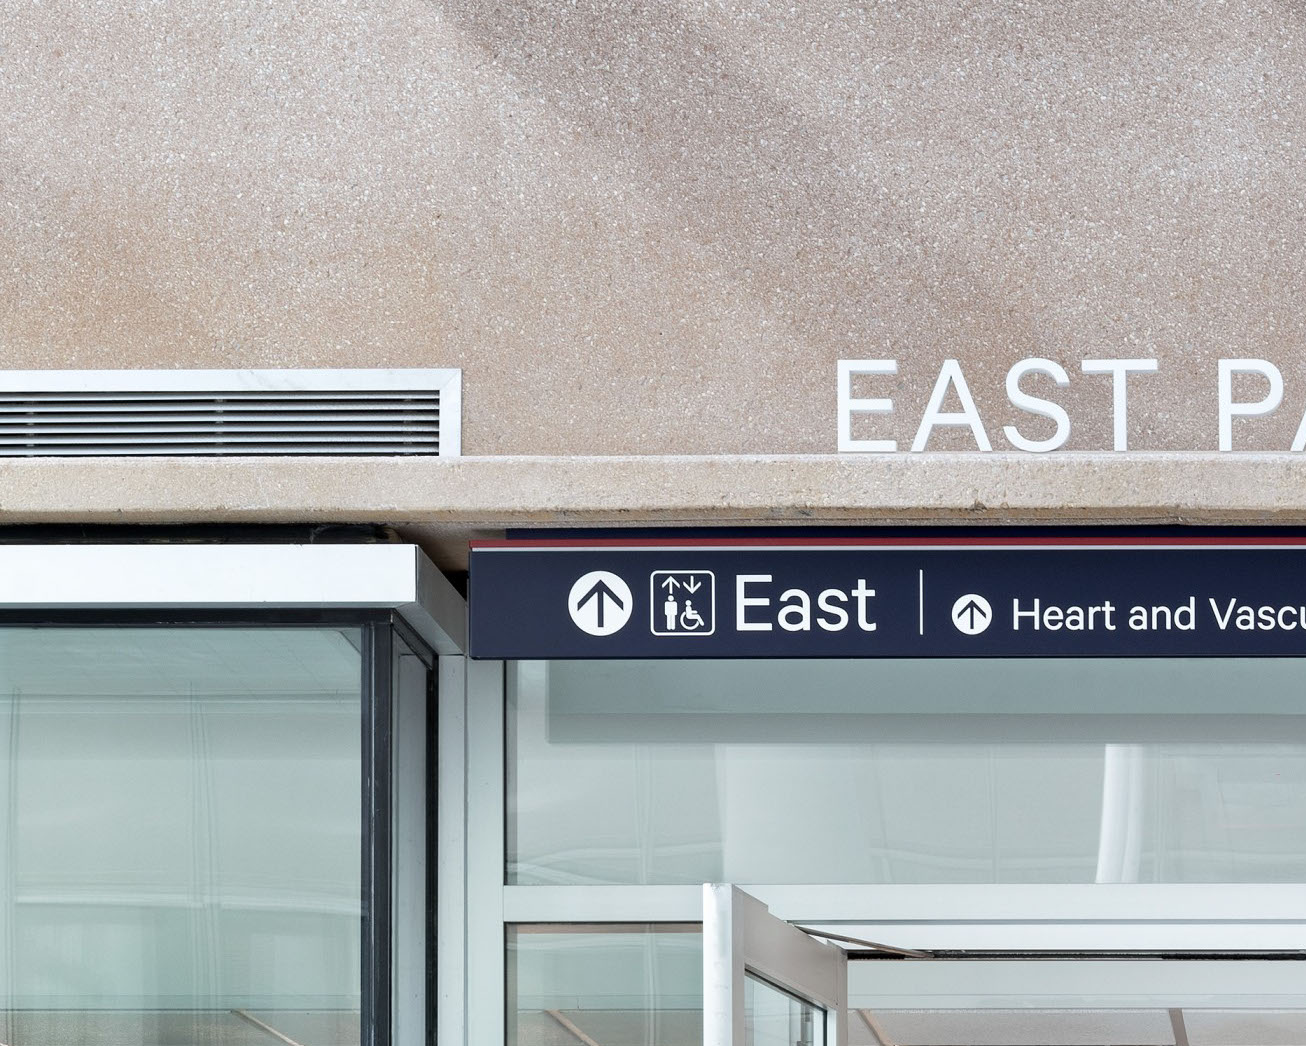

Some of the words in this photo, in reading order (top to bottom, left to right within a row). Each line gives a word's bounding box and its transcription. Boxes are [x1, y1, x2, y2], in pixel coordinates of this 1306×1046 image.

[837, 357, 1158, 453] EAST
[735, 574, 877, 632] East
[1012, 598, 1117, 631] Heart
[1128, 595, 1196, 631] and
